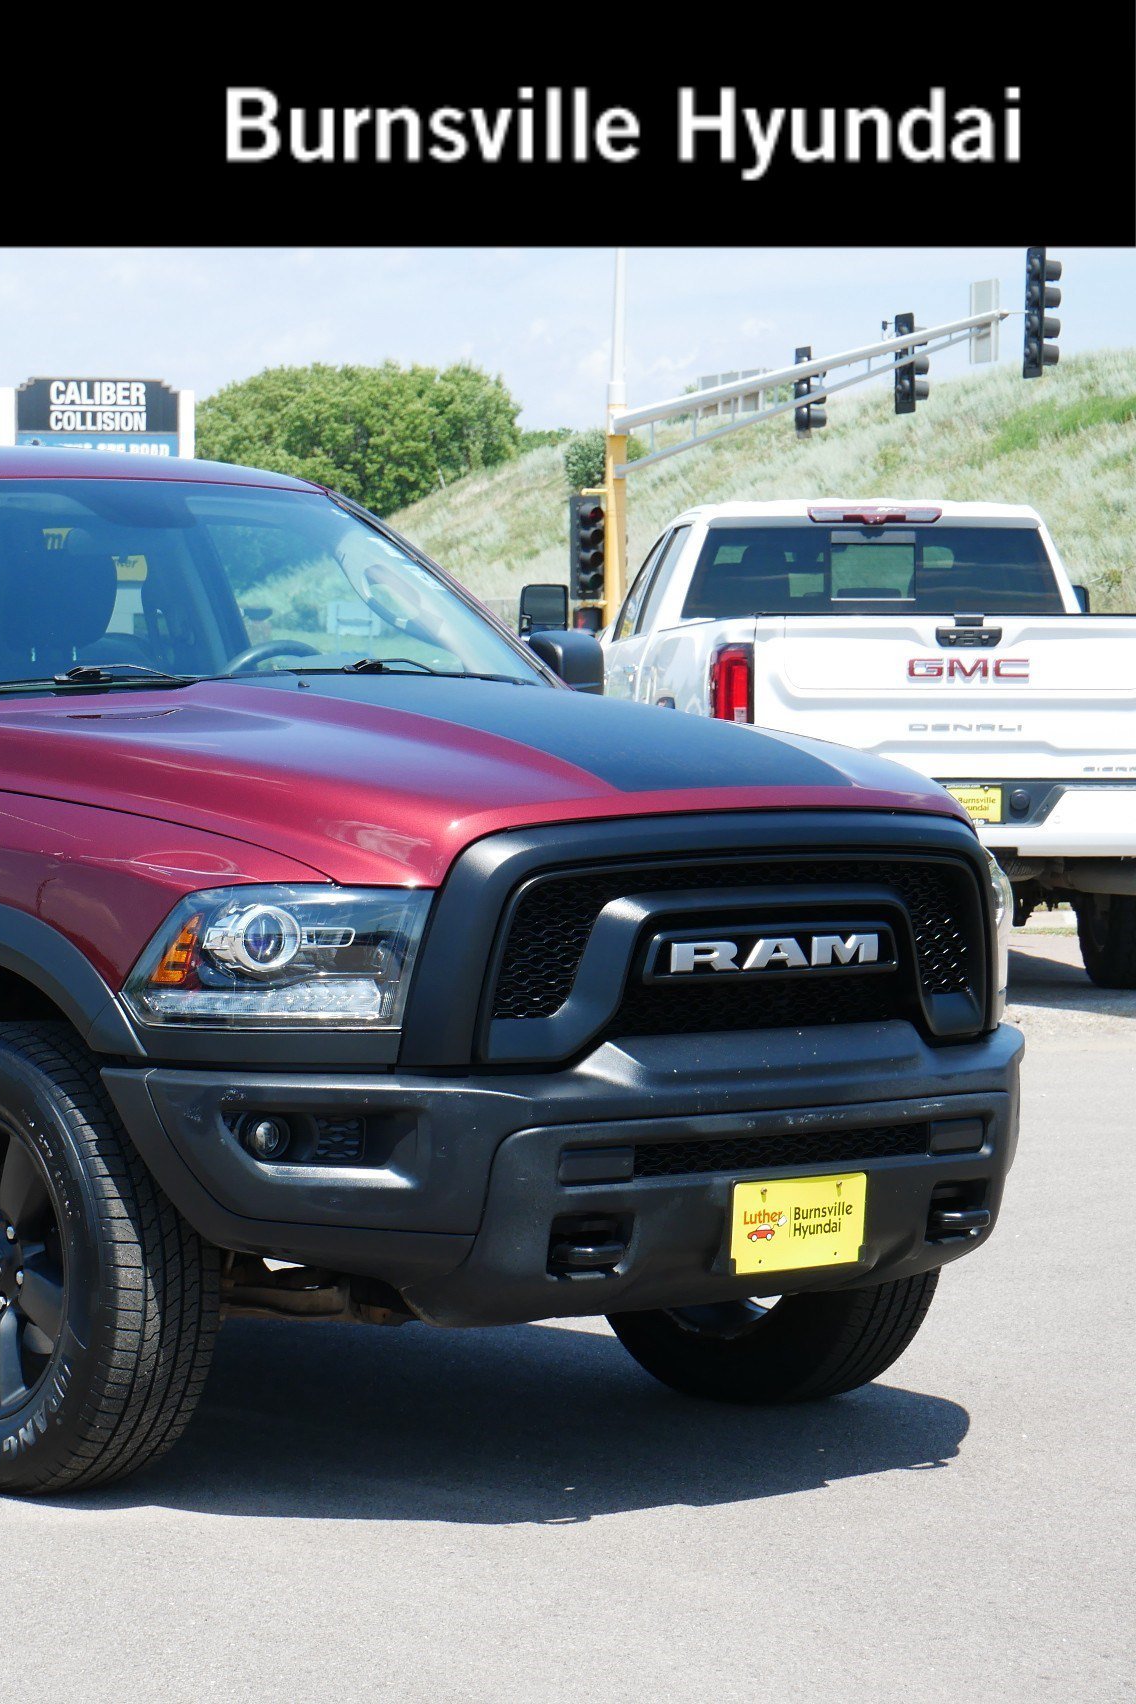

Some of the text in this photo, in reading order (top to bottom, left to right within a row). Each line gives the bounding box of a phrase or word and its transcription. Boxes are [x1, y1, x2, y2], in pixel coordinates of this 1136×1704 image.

[49, 380, 147, 406] CALIBER
[49, 411, 147, 432] COLLISION
[907, 658, 1030, 680] GMC
[908, 723, 1023, 732] DENALI
[670, 932, 879, 974] RAM
[743, 1208, 783, 1226] Luther
[793, 1201, 853, 1221] Burnsville
[792, 1217, 842, 1240] Hyundai
